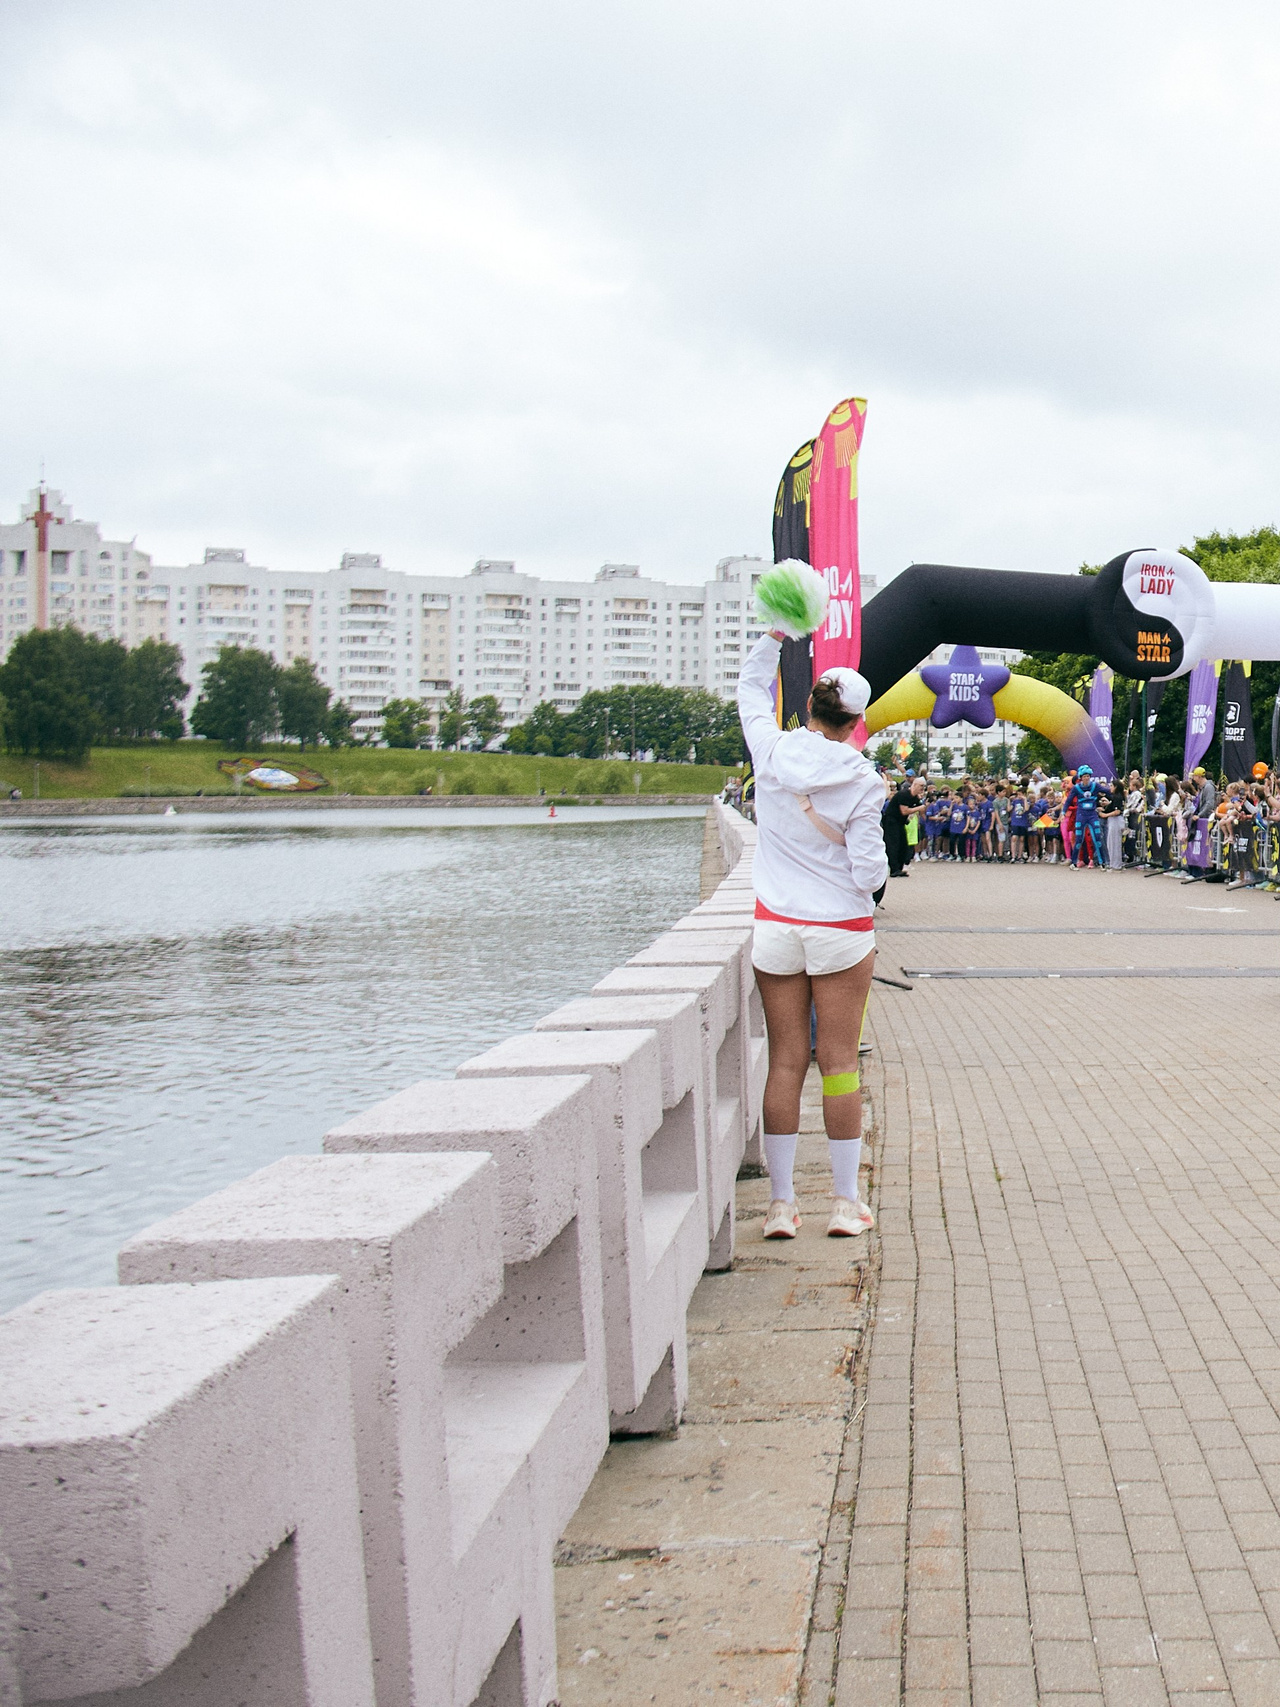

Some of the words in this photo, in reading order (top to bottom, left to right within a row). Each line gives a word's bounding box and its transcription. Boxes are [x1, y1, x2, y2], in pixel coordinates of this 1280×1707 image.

[1140, 563, 1166, 578] IRON
[1140, 577, 1175, 596] LADY
[1137, 631, 1162, 645] MAN
[1136, 645, 1171, 663] STAR
[950, 672, 975, 686] STAR
[949, 685, 980, 702] KIDS
